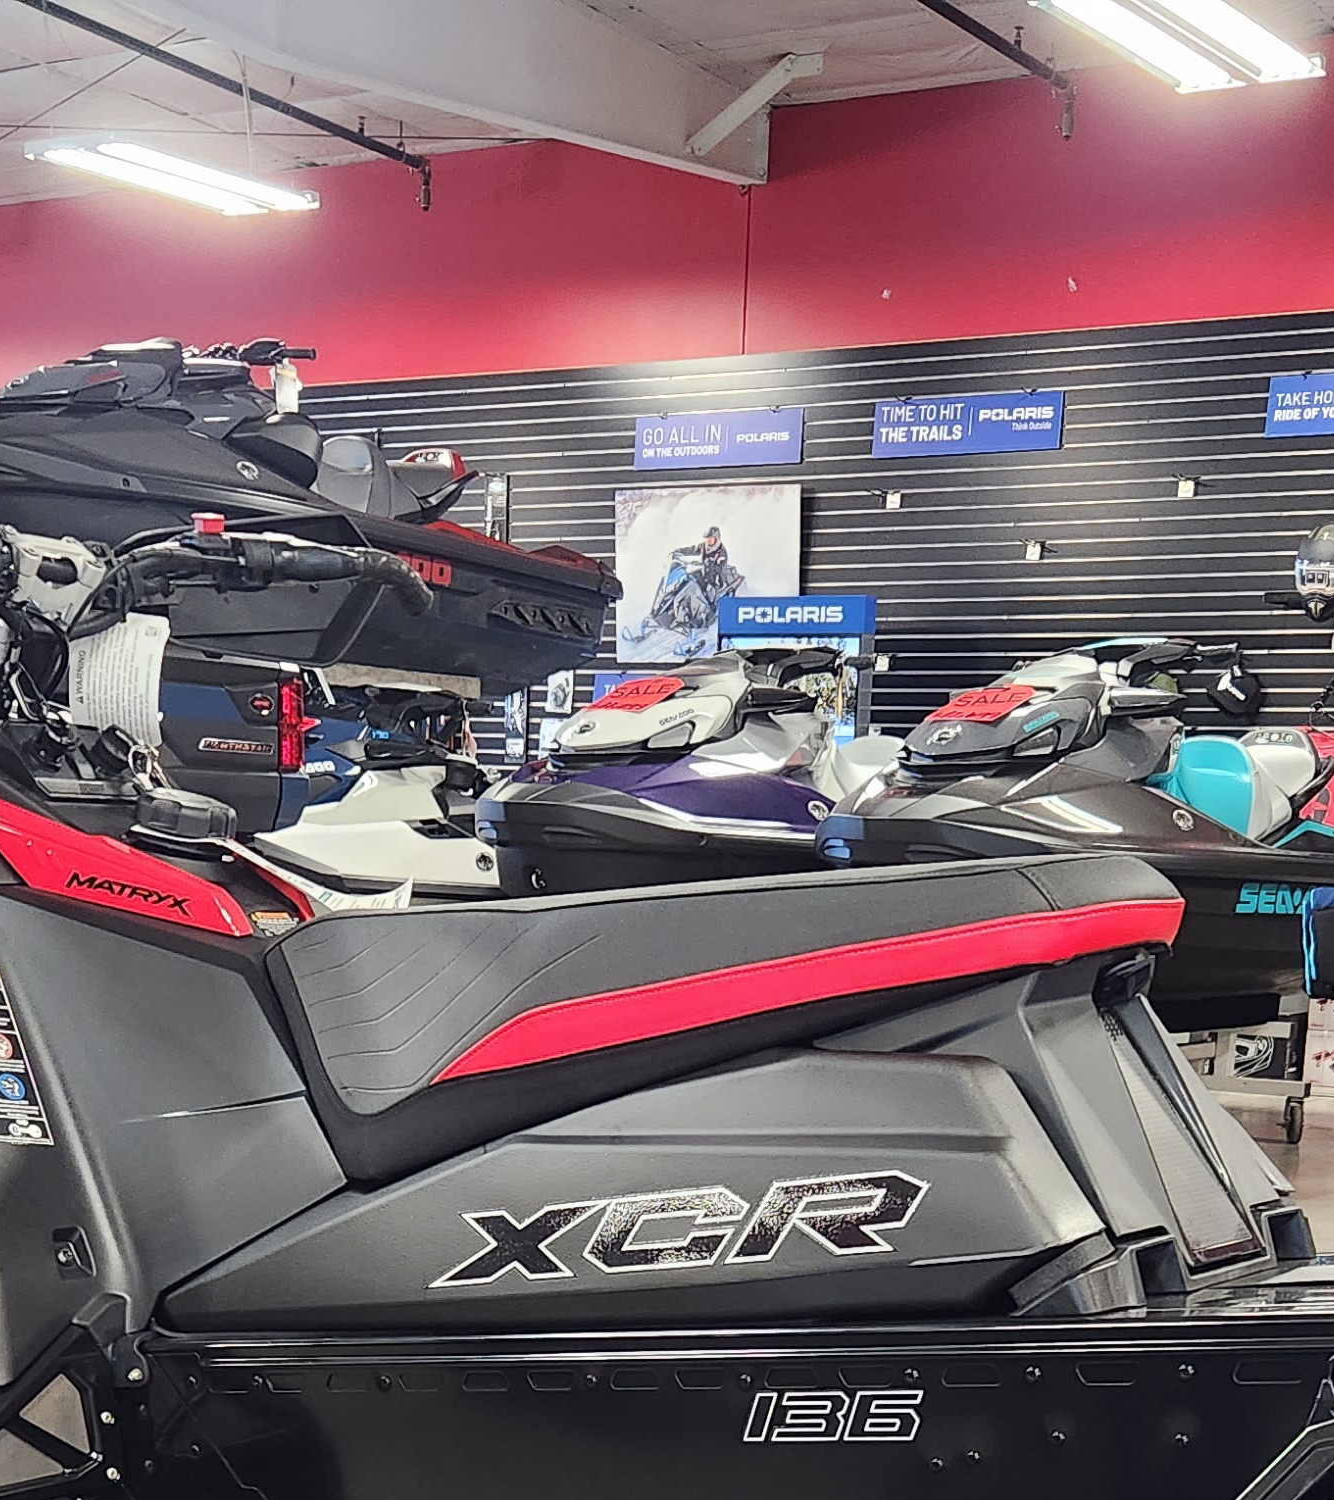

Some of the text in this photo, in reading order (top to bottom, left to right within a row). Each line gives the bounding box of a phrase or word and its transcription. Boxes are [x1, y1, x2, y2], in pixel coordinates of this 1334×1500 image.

[1276, 391, 1311, 407] TAKE
[881, 403, 965, 423] TIME TO HIT
[979, 405, 1054, 422] POLARIS
[1274, 406, 1301, 422] RIDE
[1303, 406, 1320, 420] OF
[642, 424, 722, 446] GO ALL IN
[736, 431, 790, 443] POLARIS
[880, 425, 963, 443] THE TRAILS
[642, 444, 720, 459] ON THE OUTDOORS
[737, 605, 844, 624] POLARIS
[75, 650, 86, 695] WARNING
[609, 683, 675, 699] SALE
[953, 692, 1027, 707] SALE
[65, 871, 193, 918] MATRYX
[424, 1169, 931, 1289] XCR
[744, 1390, 924, 1442] 136
